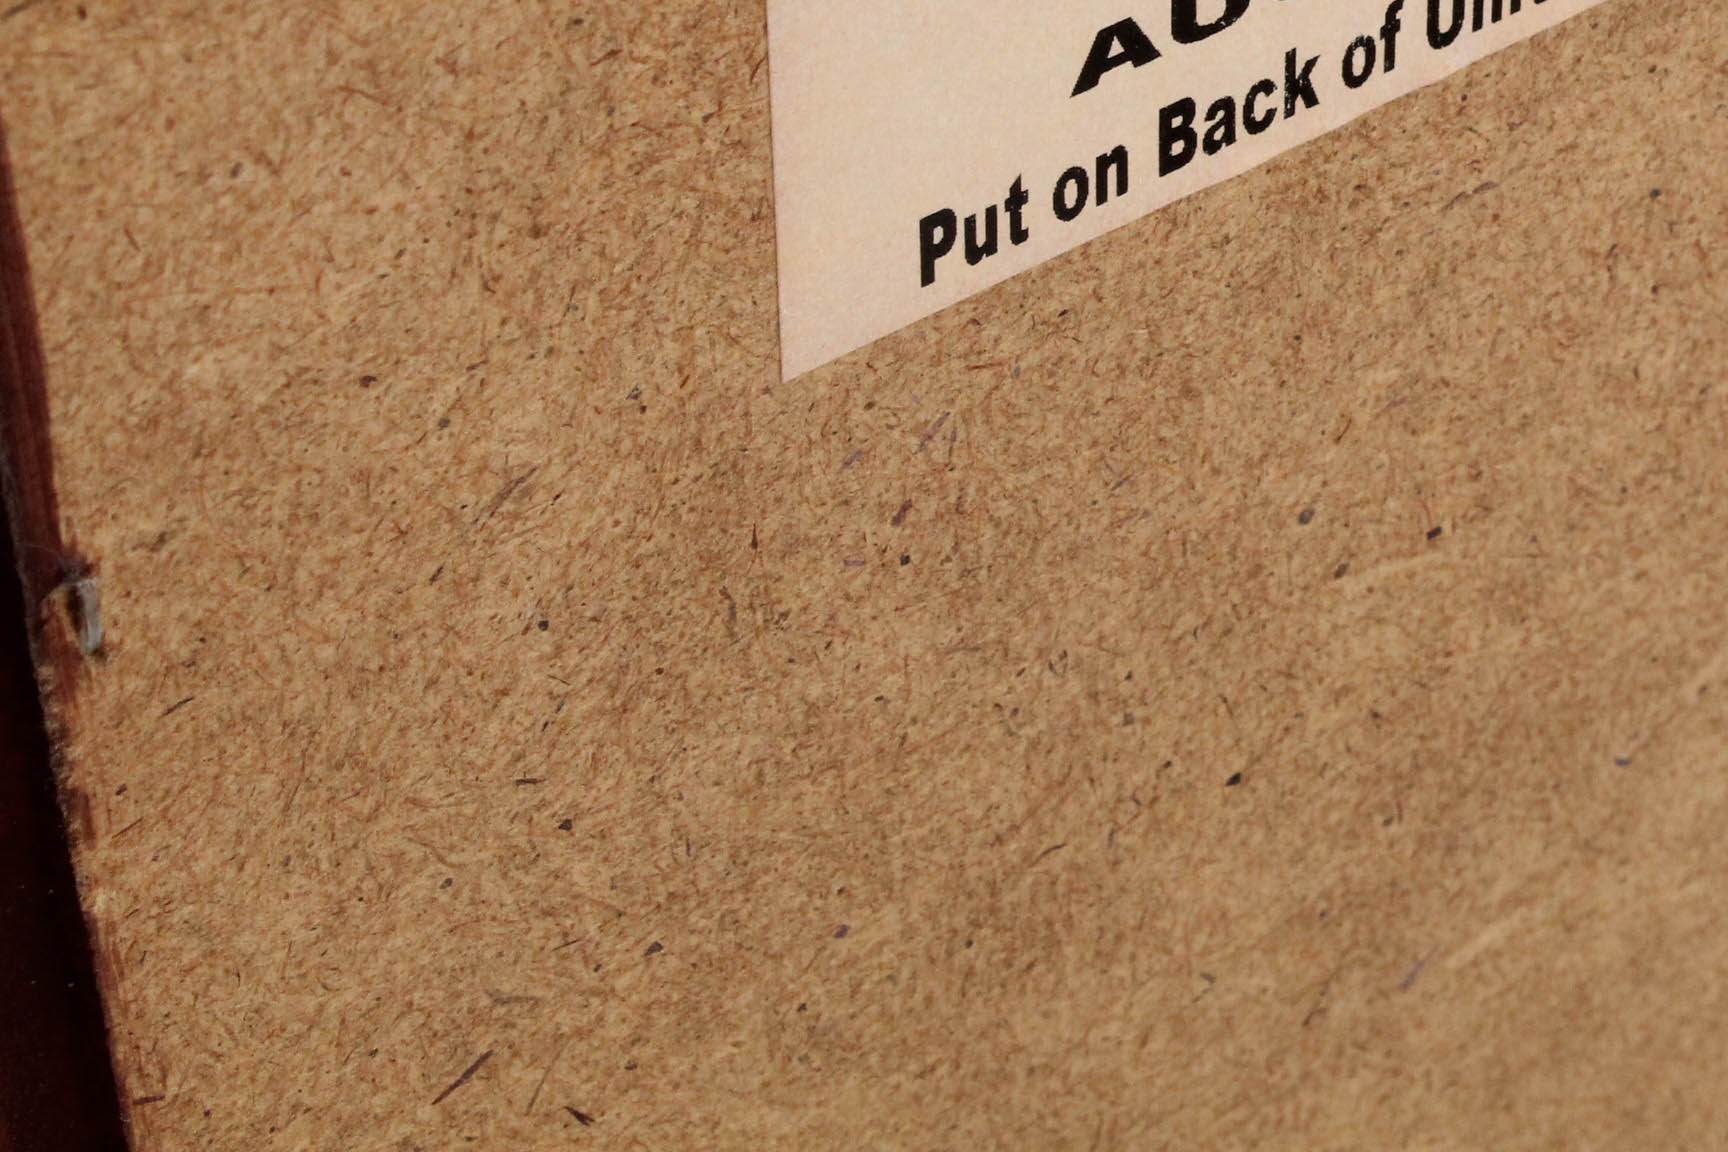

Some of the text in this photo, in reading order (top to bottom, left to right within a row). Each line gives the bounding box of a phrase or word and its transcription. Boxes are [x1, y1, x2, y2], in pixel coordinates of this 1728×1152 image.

[919, 174, 1029, 288] Put
[1052, 144, 1129, 223] on
[1158, 47, 1321, 178] Back
